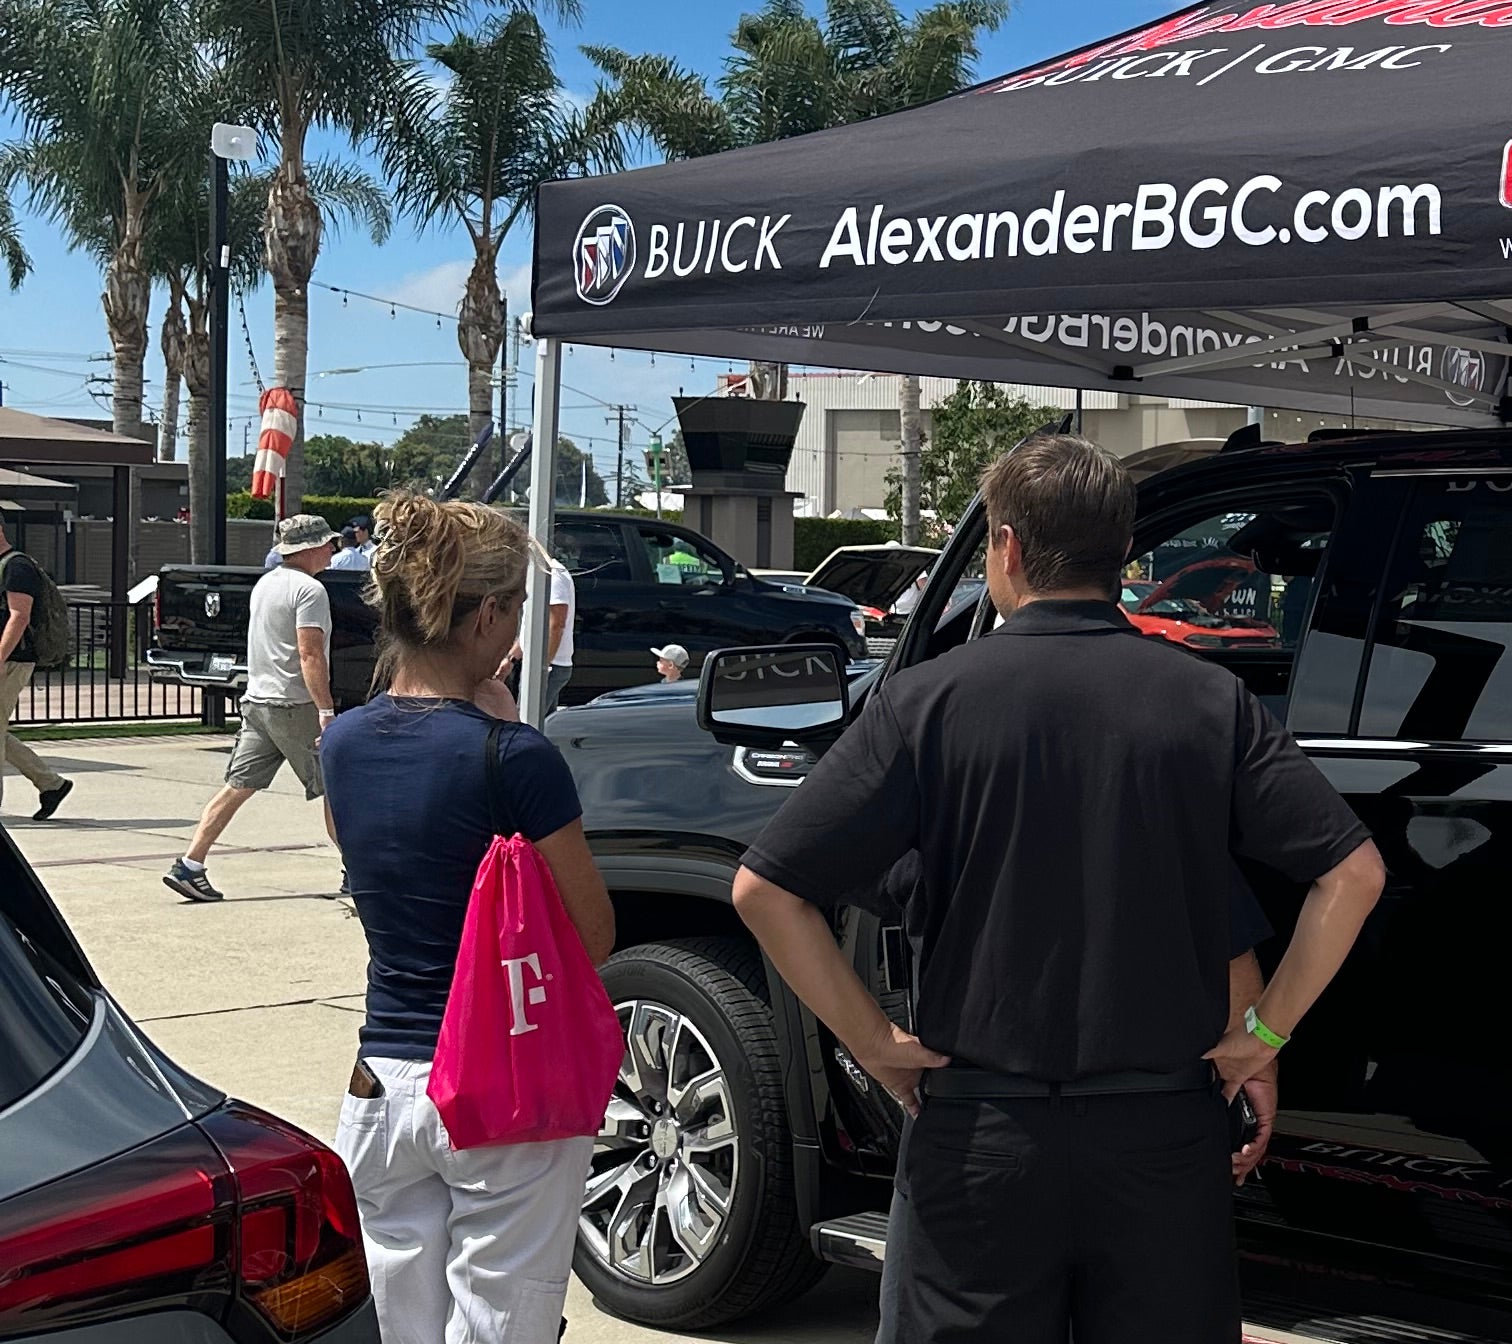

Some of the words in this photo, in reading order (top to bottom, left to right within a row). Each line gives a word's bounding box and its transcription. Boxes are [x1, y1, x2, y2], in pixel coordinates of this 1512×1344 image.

[993, 48, 1229, 94] BUICK
[1254, 44, 1452, 75] GMC
[643, 214, 792, 279] BUICK
[819, 175, 1443, 269] AlexanderBGC.com
